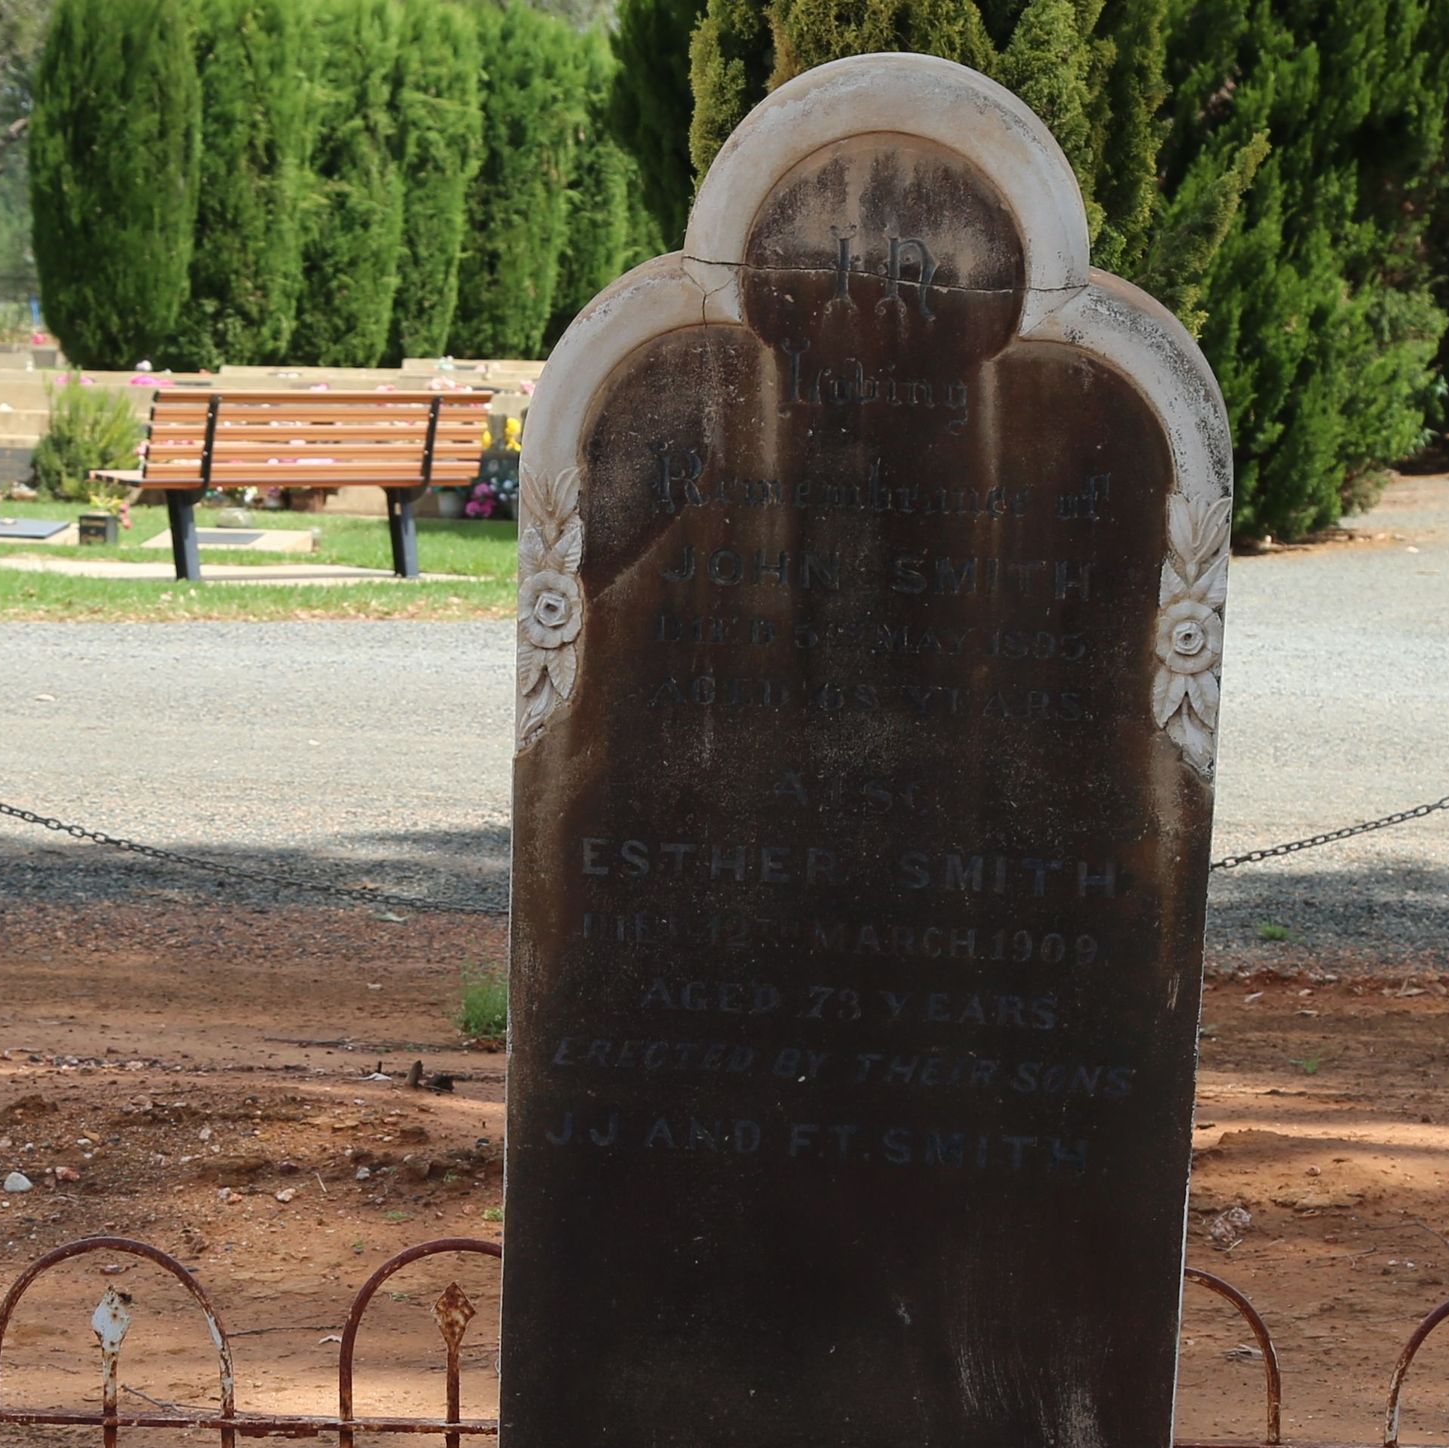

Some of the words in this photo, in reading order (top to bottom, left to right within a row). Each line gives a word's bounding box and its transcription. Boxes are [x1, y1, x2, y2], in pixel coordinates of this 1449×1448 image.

[659, 545, 842, 590] JOHN
[887, 556, 1092, 602] SMITH
[656, 615, 775, 645] DIED
[876, 624, 977, 655] MAY
[648, 676, 792, 707] AGED
[903, 685, 1082, 722] YEARS
[580, 837, 839, 886] ESTHER
[901, 853, 1116, 898] SMITH
[990, 928, 1099, 968] 1909
[640, 978, 781, 1014] AGED
[879, 990, 1058, 1031] YEARS
[553, 1036, 755, 1073] ERECTED
[771, 1047, 830, 1079] BY
[855, 1053, 1000, 1088] THEIR
[1009, 1060, 1136, 1099] SONS
[645, 1117, 762, 1153] AND
[882, 1127, 1089, 1171] SMITH
